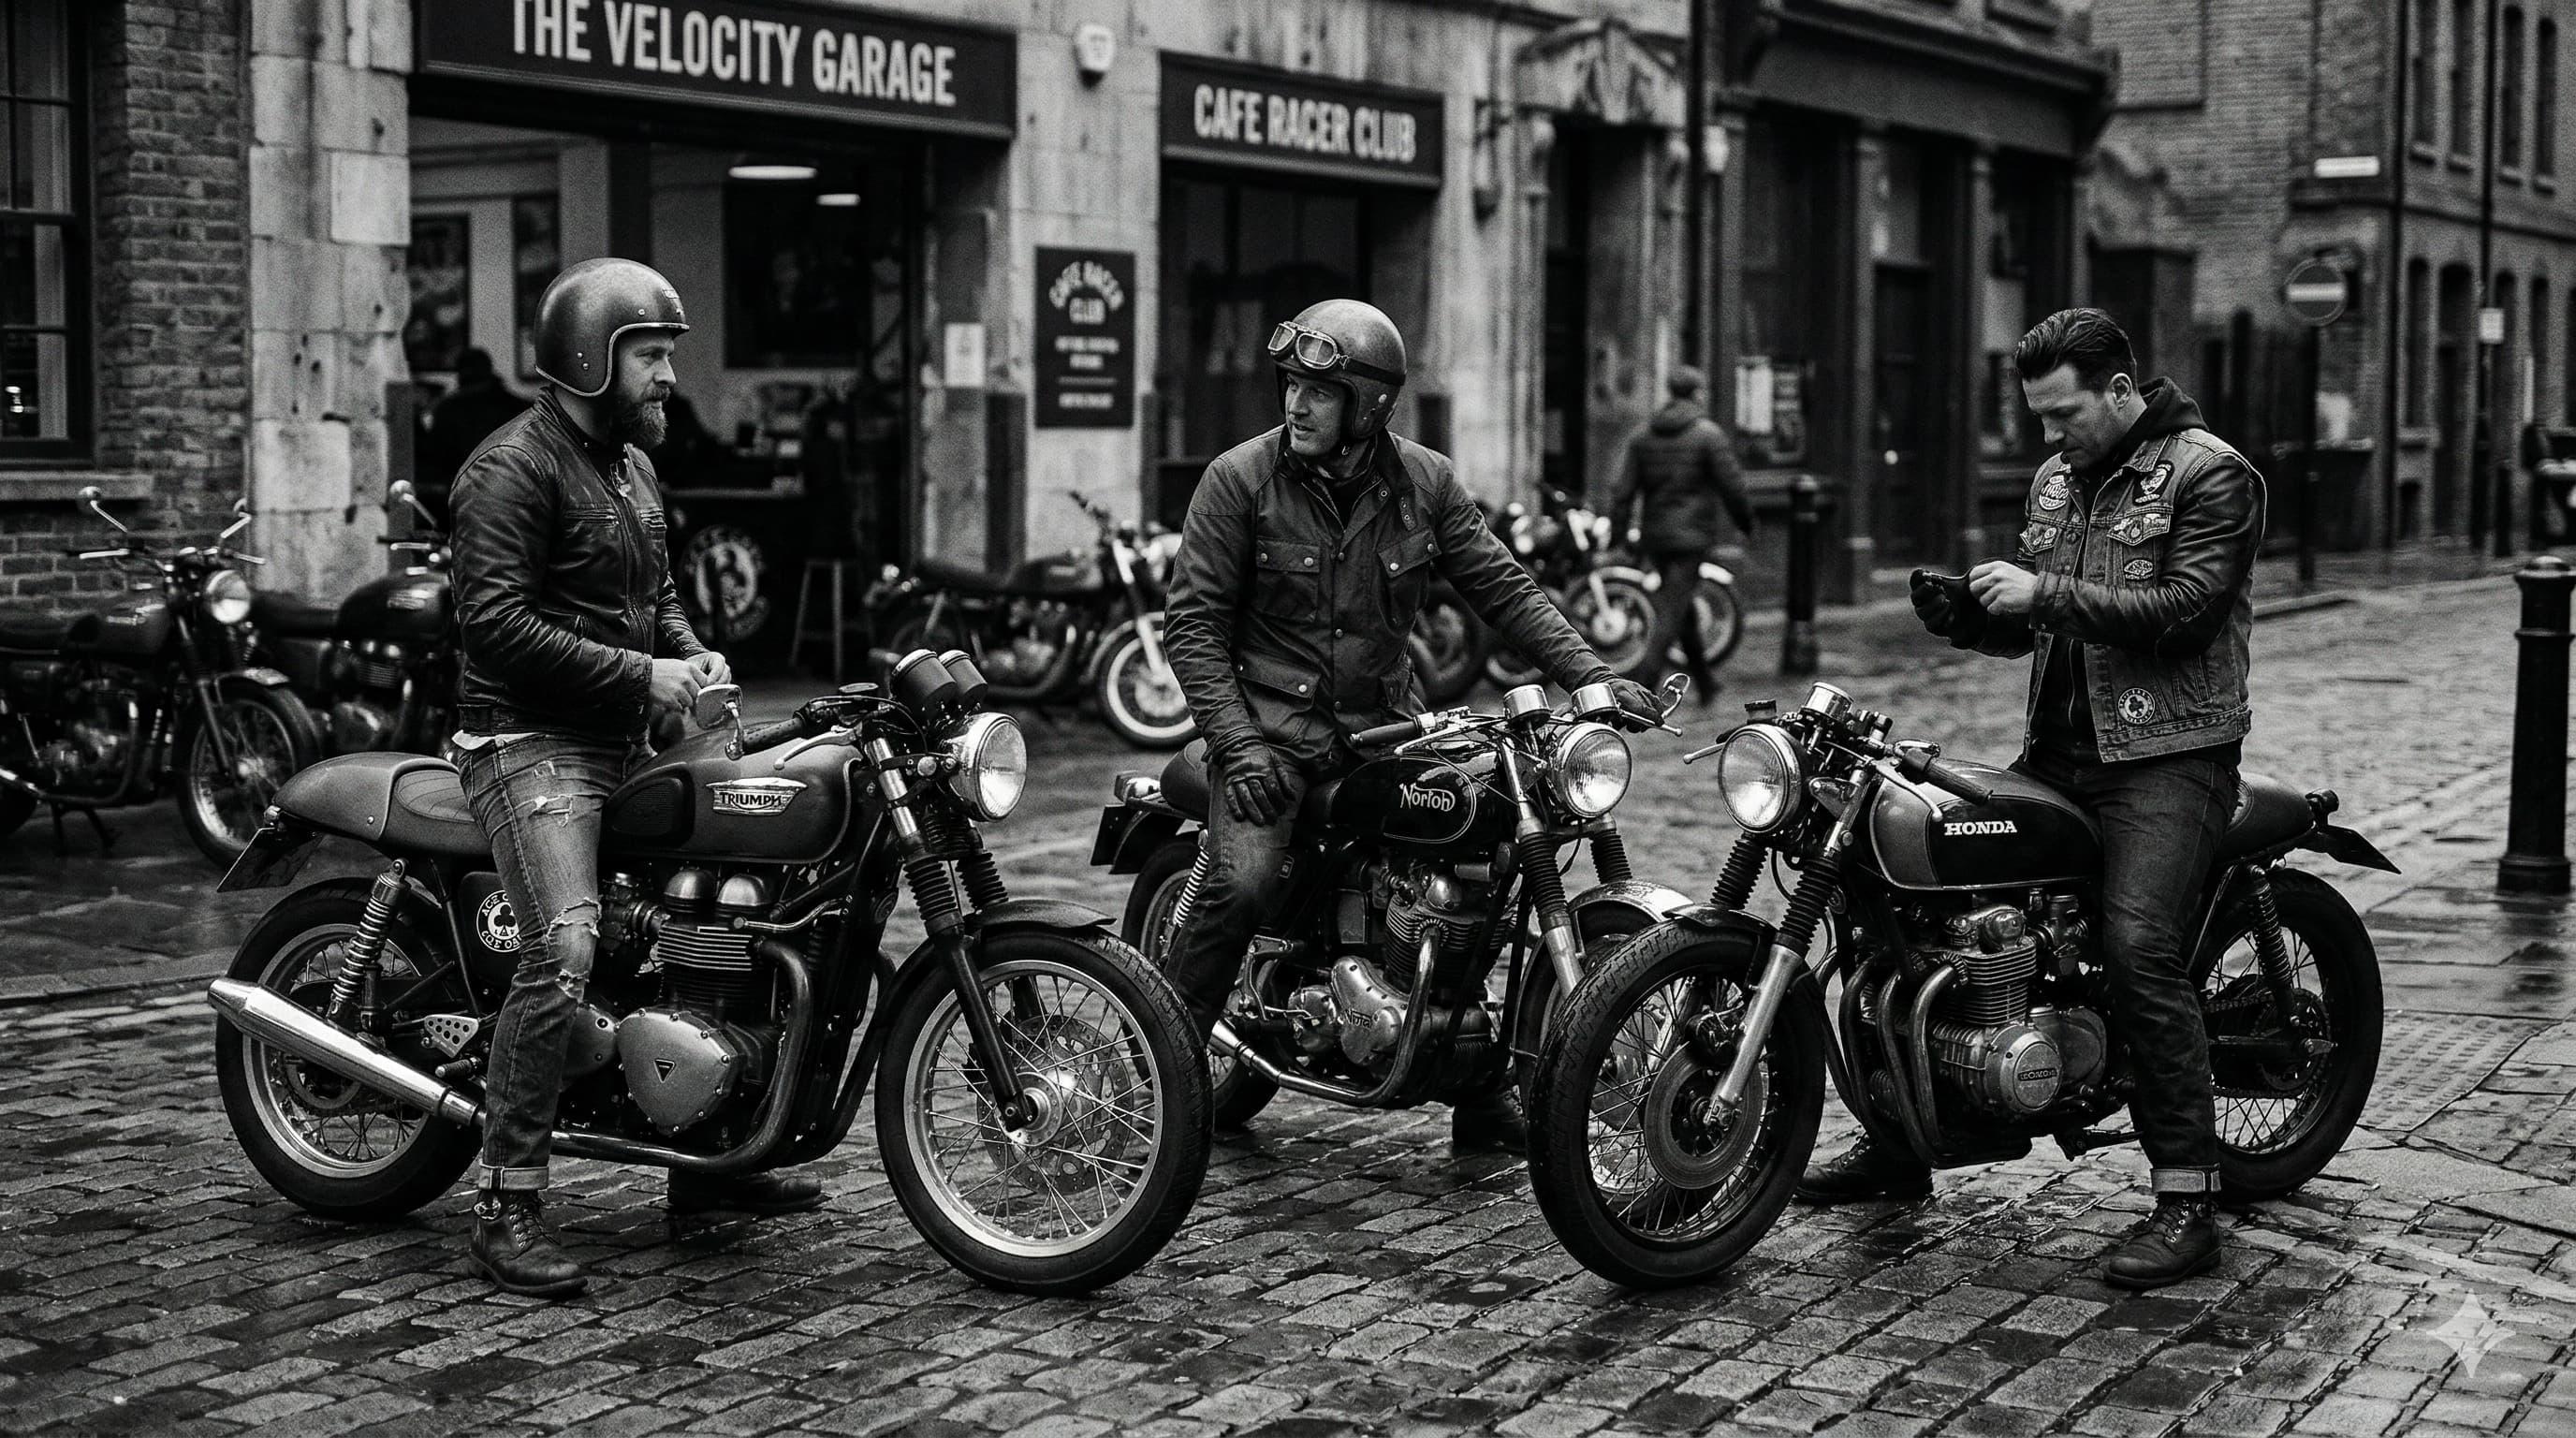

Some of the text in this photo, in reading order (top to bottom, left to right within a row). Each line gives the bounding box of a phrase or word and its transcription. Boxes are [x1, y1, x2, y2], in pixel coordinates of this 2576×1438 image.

[514, 0, 956, 106] THE VELOCITY GARAGE
[1194, 84, 1416, 163] CAFE RACER CLUB
[1944, 820, 2018, 836] HONDA
[481, 894, 500, 917] ACE
